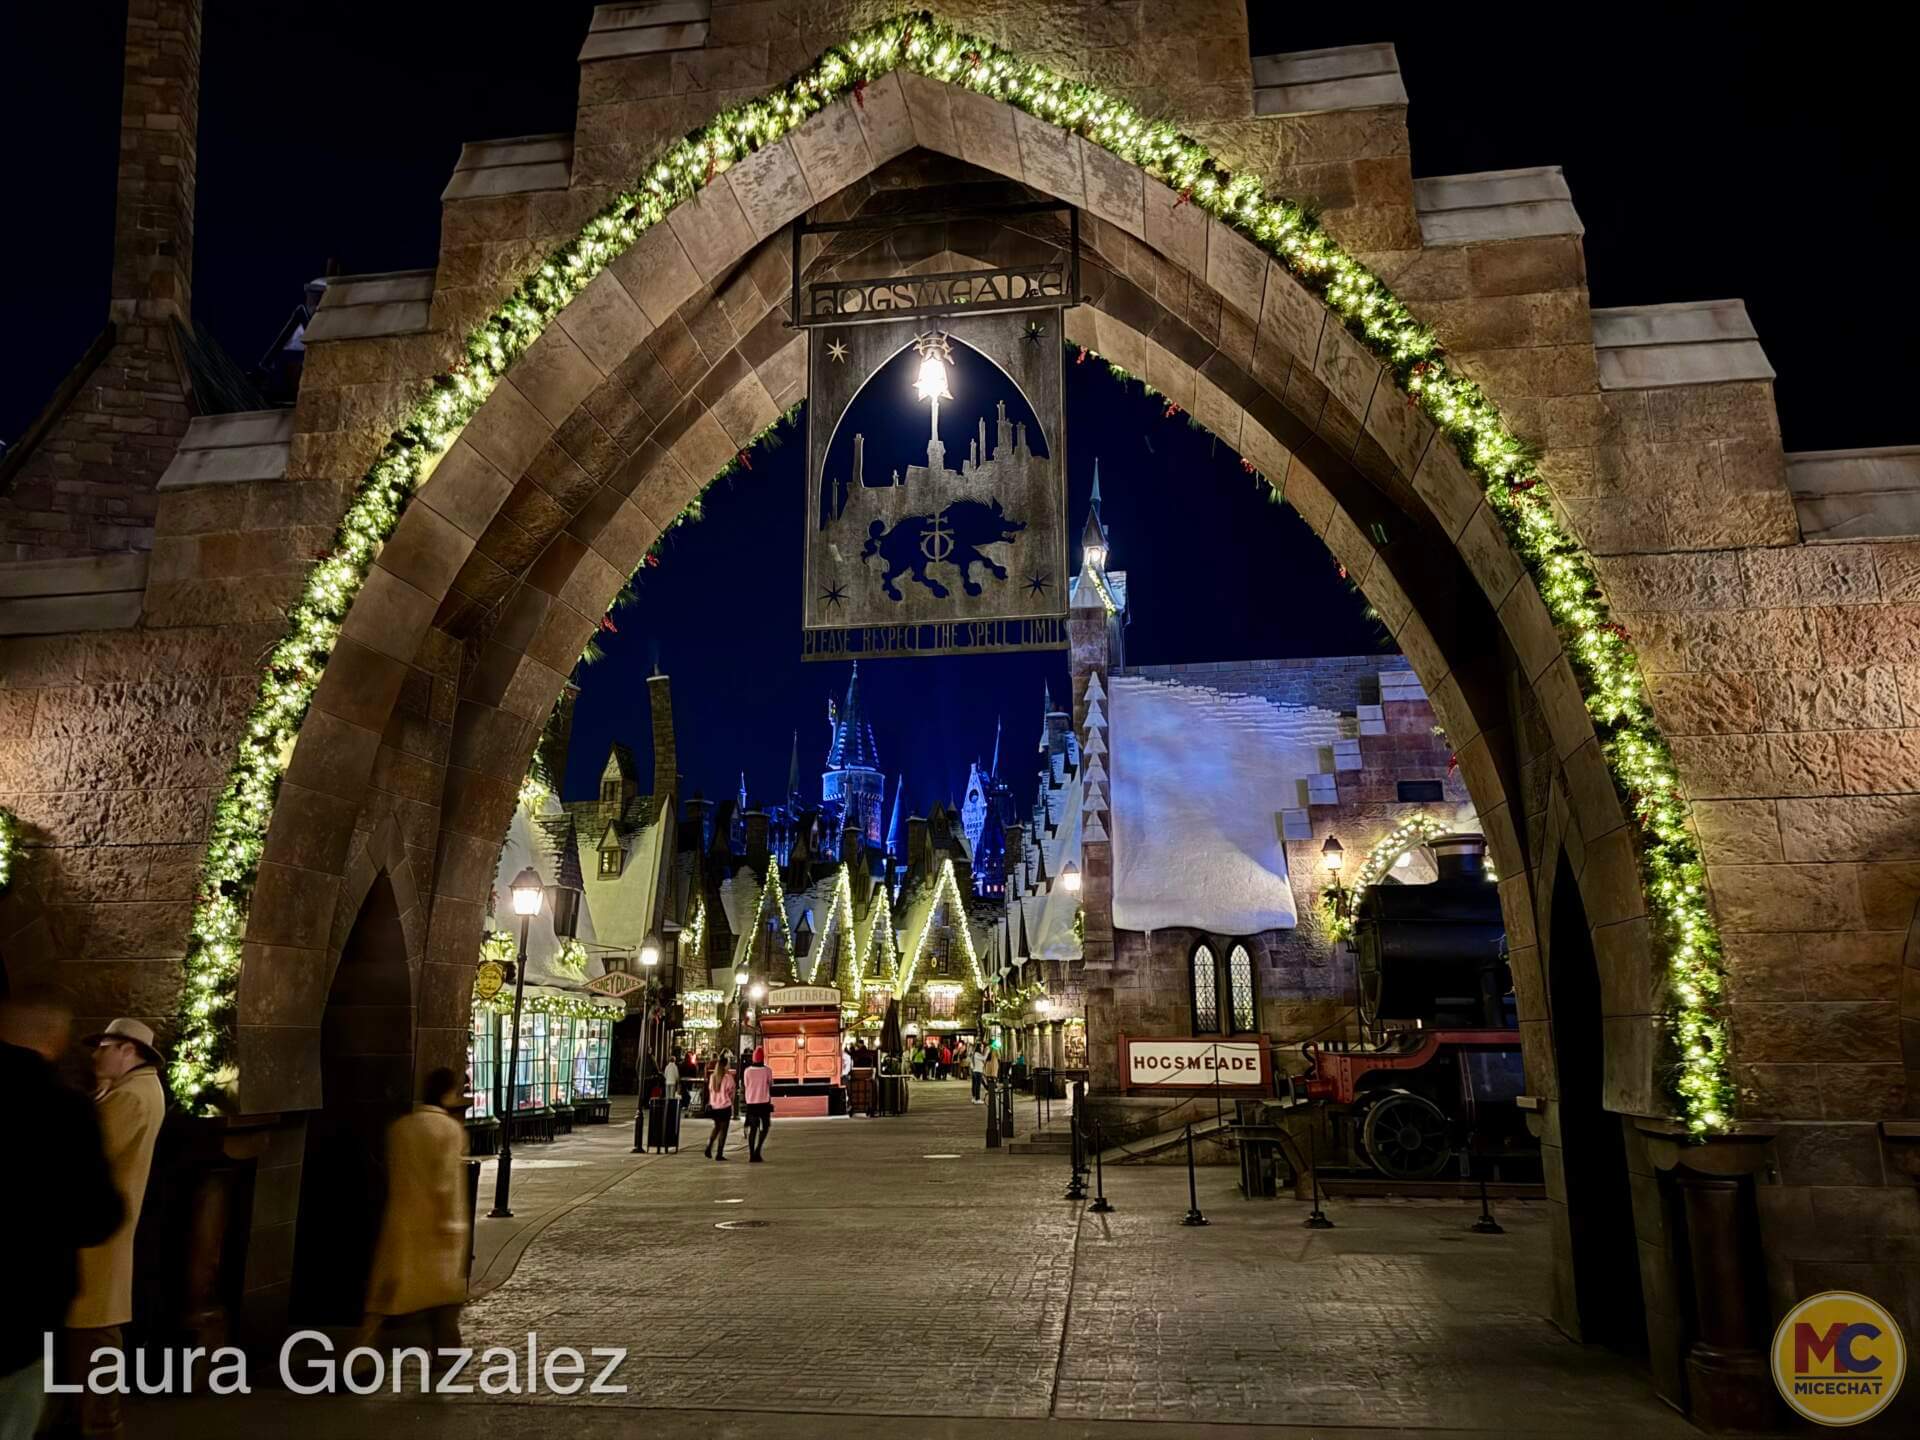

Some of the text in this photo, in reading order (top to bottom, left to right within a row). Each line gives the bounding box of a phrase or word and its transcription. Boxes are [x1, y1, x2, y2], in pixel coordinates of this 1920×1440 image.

[811, 270, 1064, 315] HOGSMEADE
[804, 617, 1069, 655] PLEASE RESPECT THE SPELL LIMITS
[773, 989, 837, 1003] BUTTERBEER
[1134, 1056, 1256, 1070] HOGSMEADE
